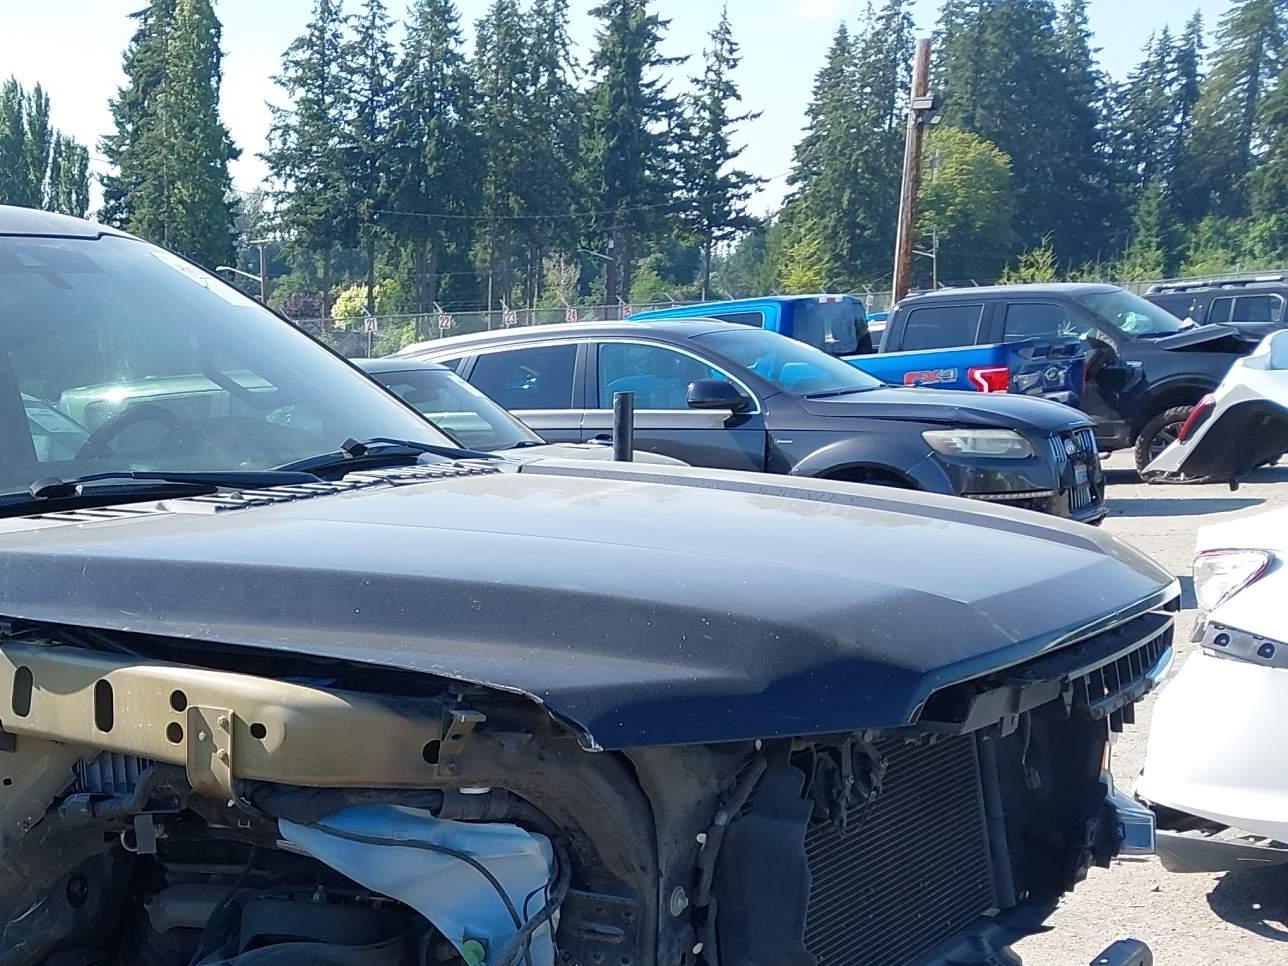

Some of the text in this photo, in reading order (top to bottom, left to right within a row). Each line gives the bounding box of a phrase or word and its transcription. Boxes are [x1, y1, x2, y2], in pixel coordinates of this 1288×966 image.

[505, 311, 515, 324] 23
[567, 309, 576, 321] 24
[366, 318, 376, 331] 21
[439, 316, 450, 328] 22
